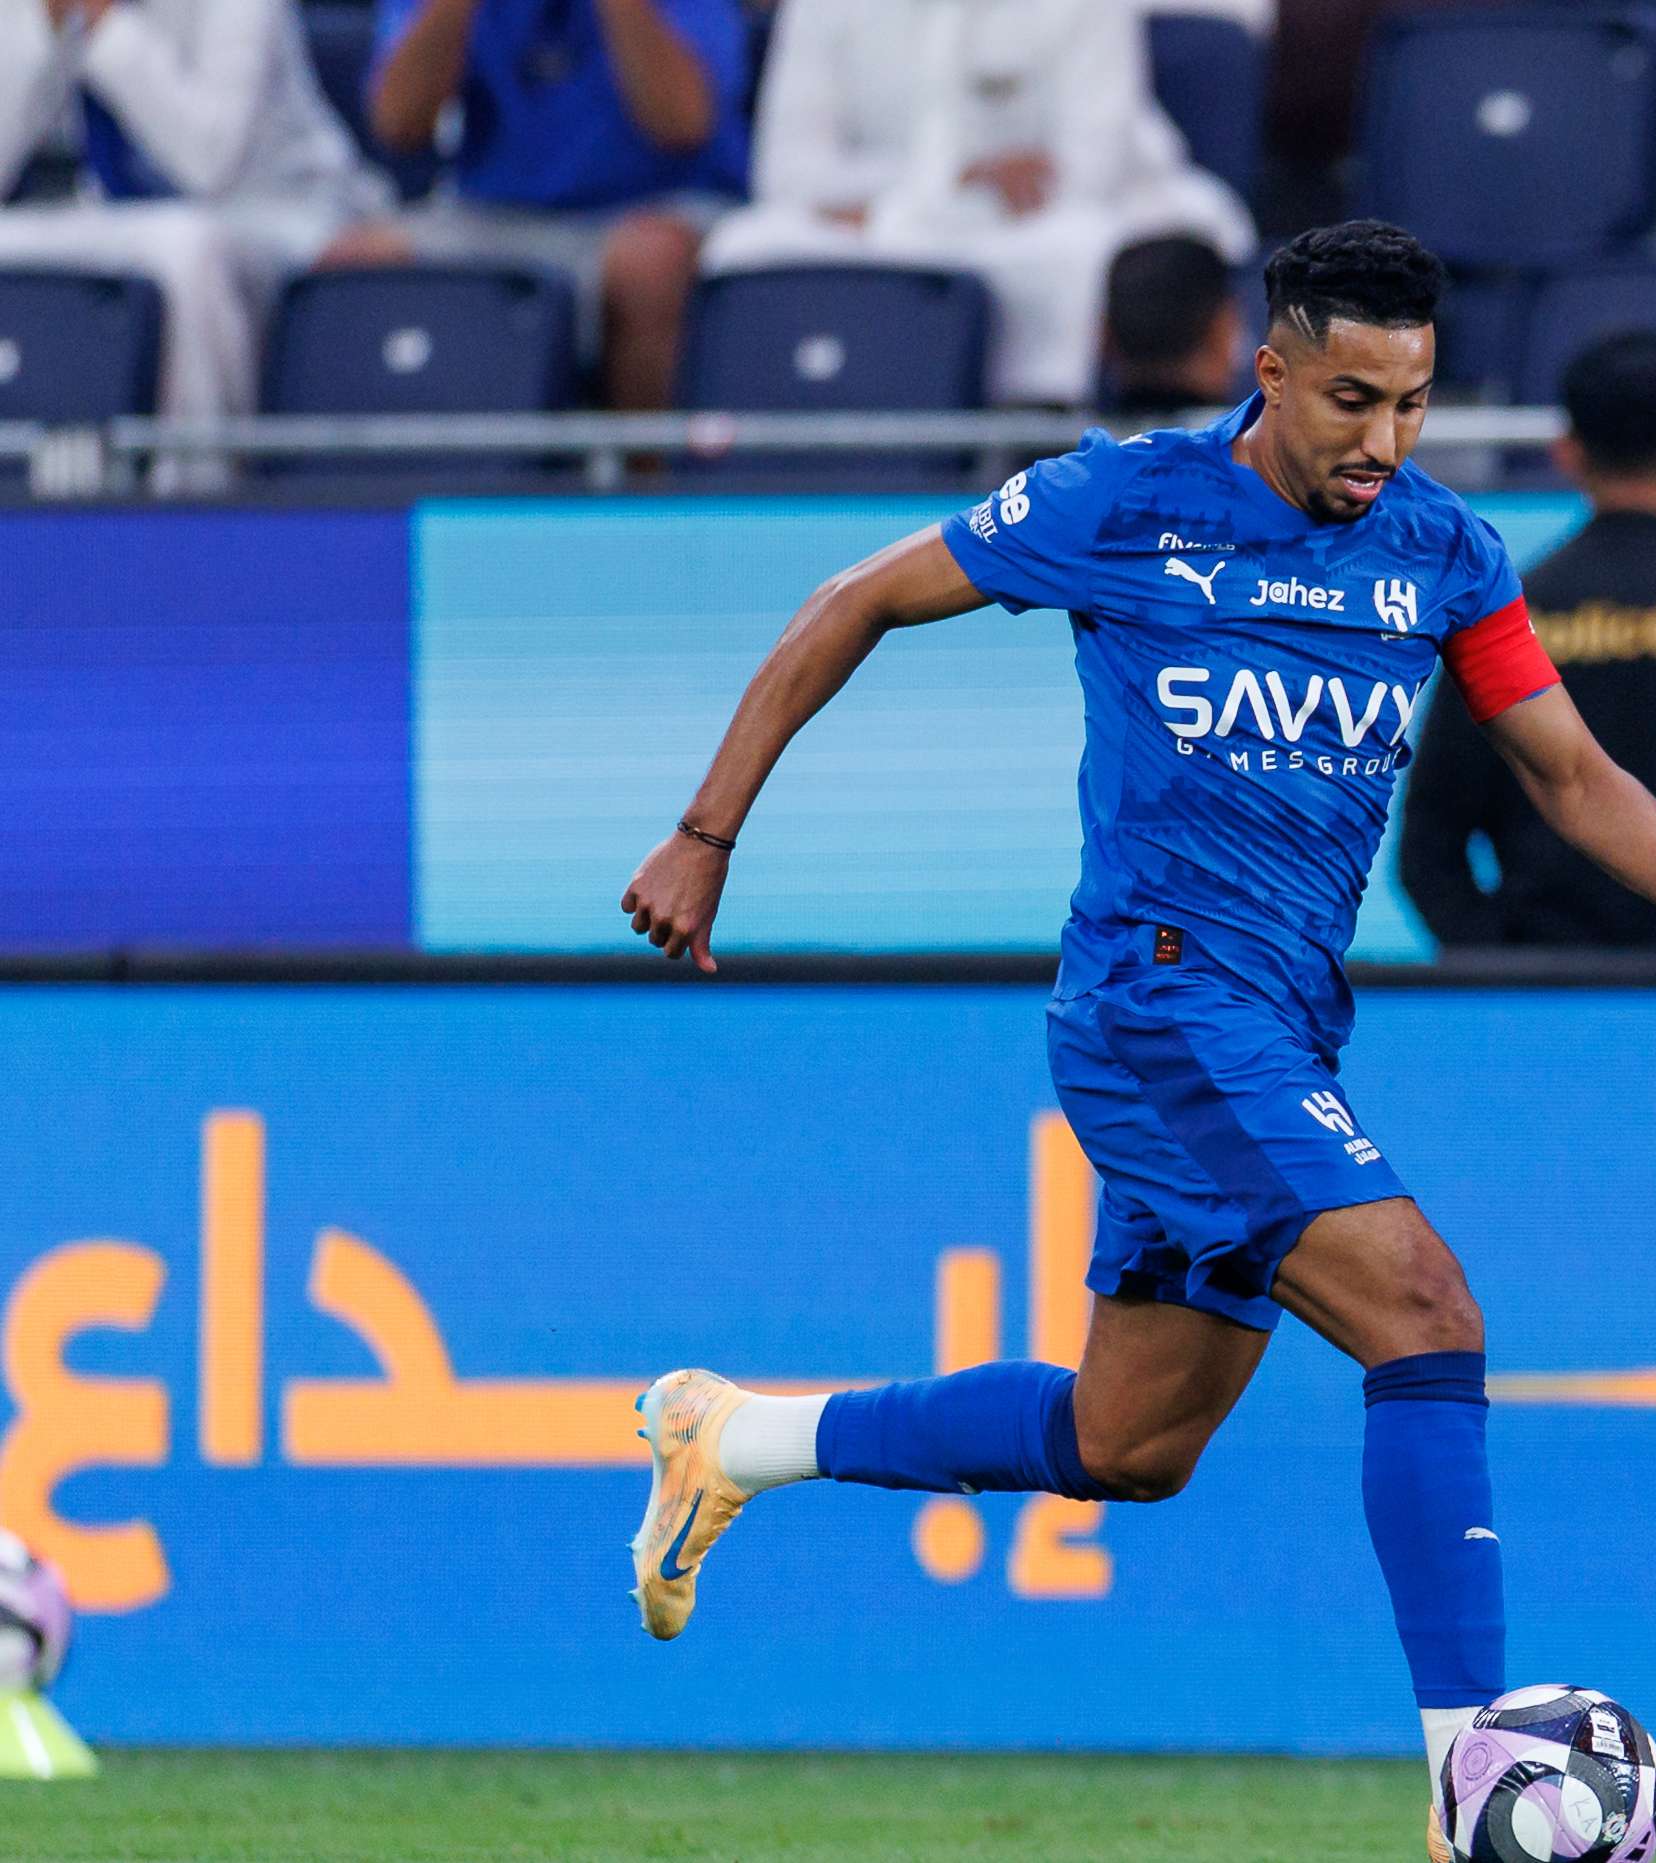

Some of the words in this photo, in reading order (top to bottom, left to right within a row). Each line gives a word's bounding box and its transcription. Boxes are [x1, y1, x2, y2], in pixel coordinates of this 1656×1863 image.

[1157, 666, 1421, 747] SAVVY
[1177, 737, 1304, 771] GMES
[1317, 746, 1403, 776] GROU
